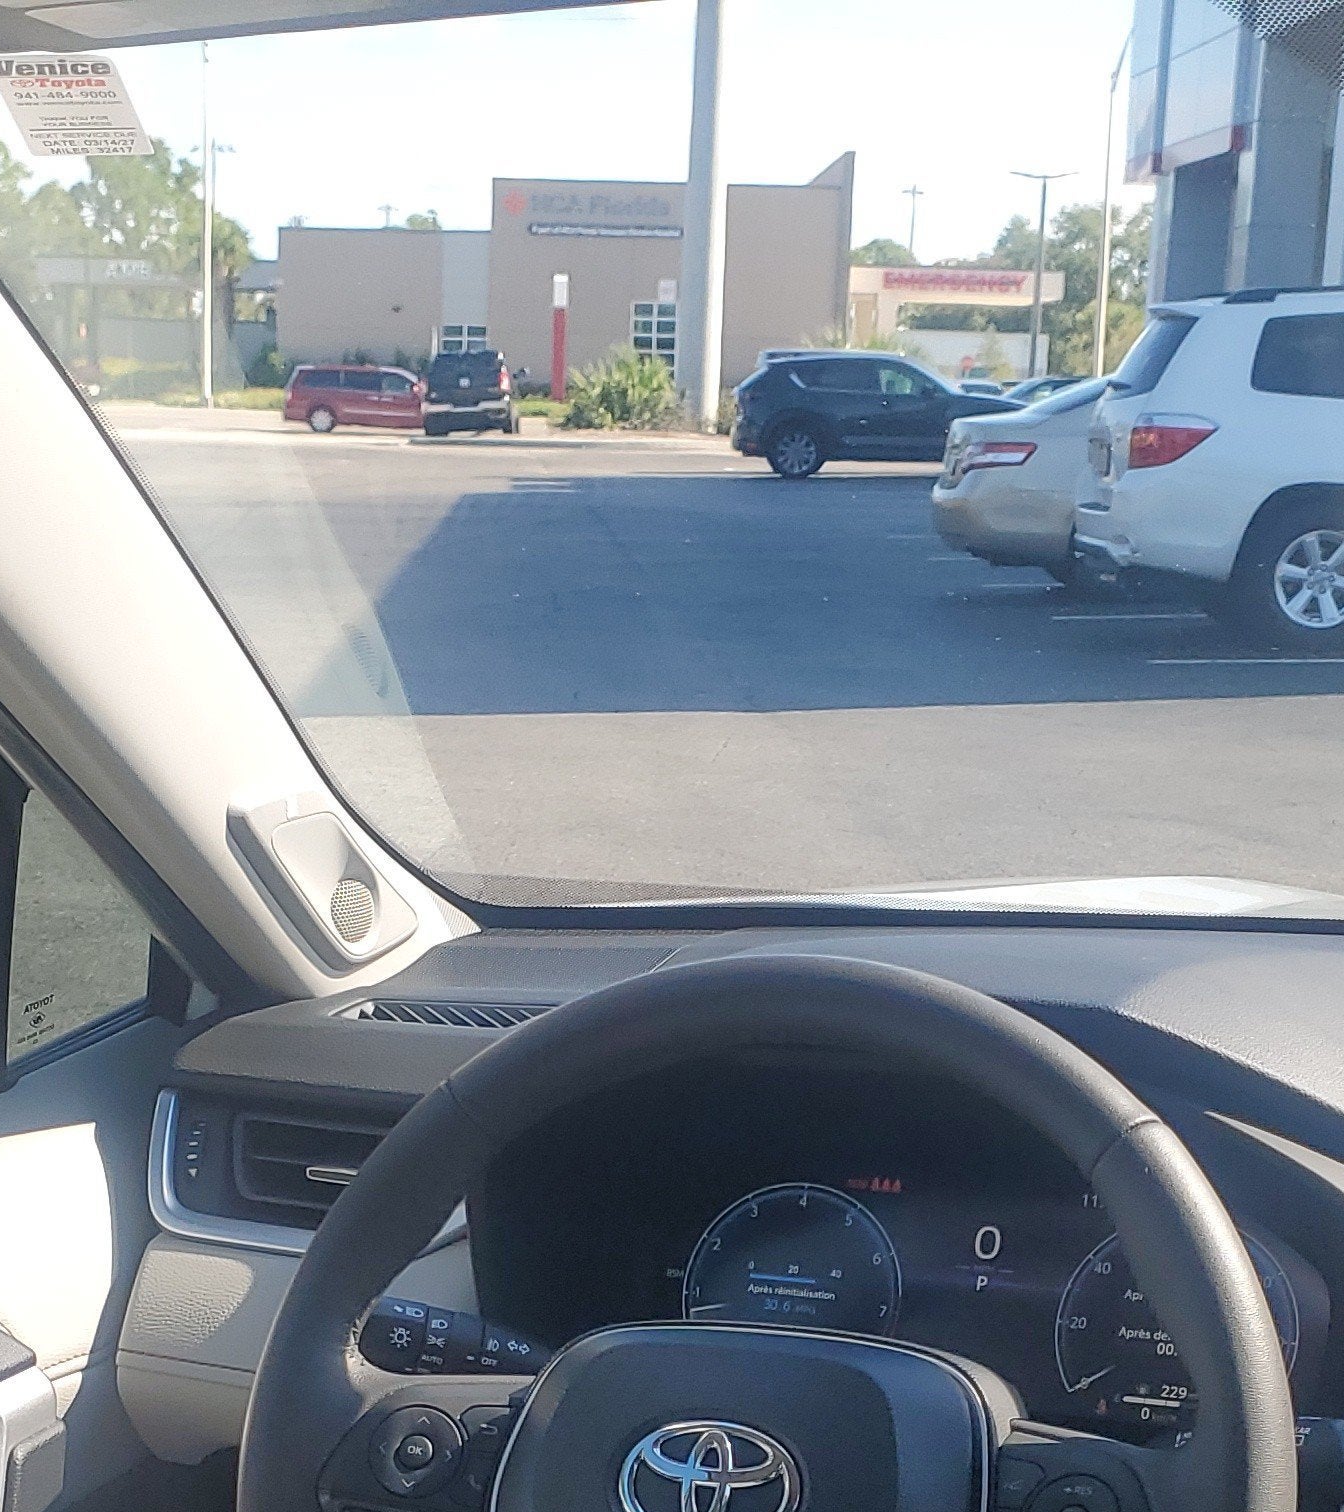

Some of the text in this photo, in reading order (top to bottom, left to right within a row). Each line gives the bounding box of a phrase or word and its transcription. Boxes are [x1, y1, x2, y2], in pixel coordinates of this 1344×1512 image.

[36, 78, 107, 89] Toyota
[14, 91, 117, 99] 941-484-9000
[844, 1213, 853, 1226] 5
[711, 1238, 721, 1250] 2
[974, 1226, 1001, 1260] 0
[872, 1252, 882, 1265] 6
[788, 1264, 799, 1274] 20
[830, 1268, 842, 1279] 40
[1094, 1261, 1112, 1274] 40
[748, 1283, 773, 1295] Après
[976, 1276, 988, 1291] P
[879, 1305, 888, 1317] 7
[1070, 1317, 1087, 1330] 20
[1119, 1326, 1151, 1340] Après
[422, 1354, 498, 1367] AUTO OFF
[1161, 1385, 1188, 1400] 229
[1140, 1407, 1151, 1421] 0
[408, 1446, 423, 1456] OK
